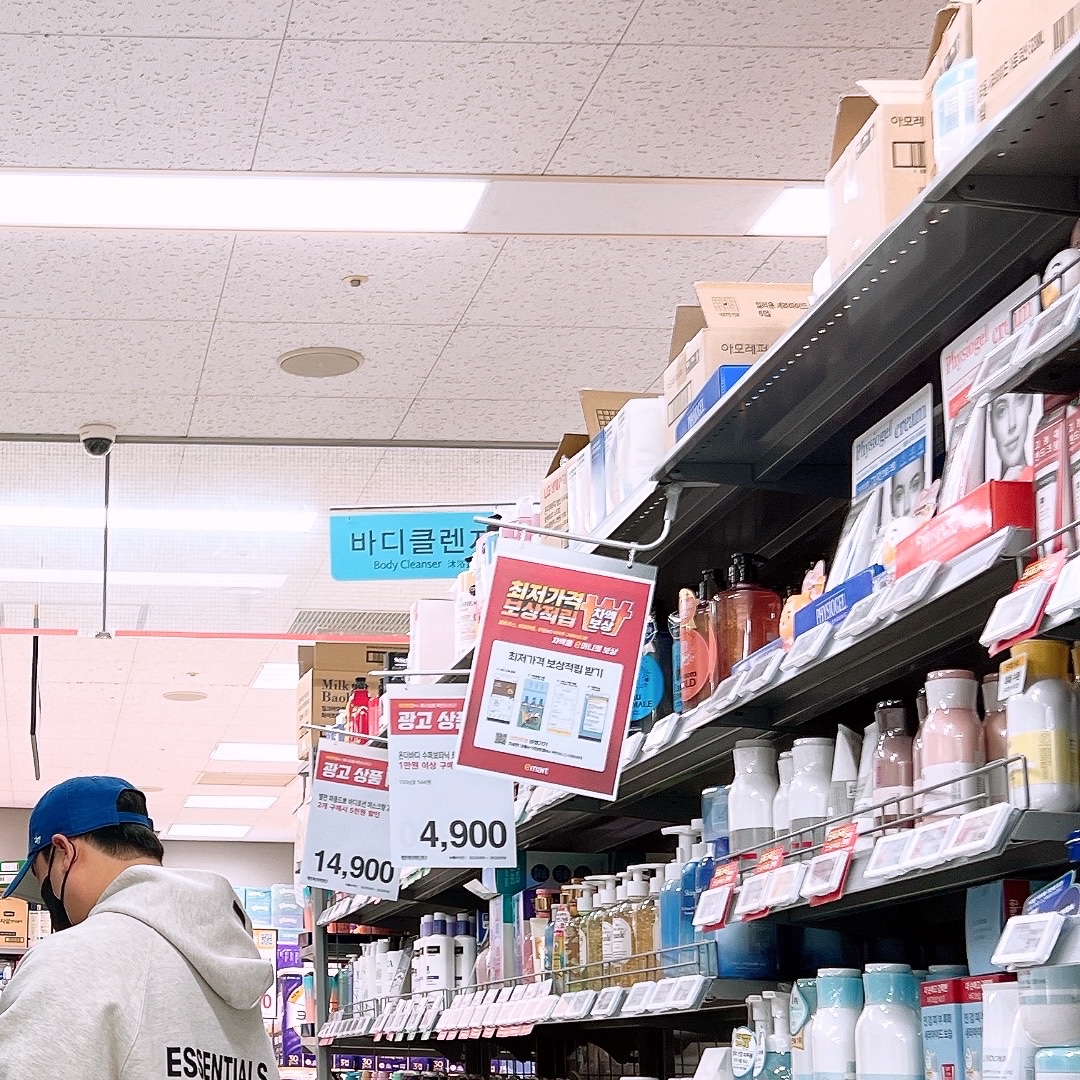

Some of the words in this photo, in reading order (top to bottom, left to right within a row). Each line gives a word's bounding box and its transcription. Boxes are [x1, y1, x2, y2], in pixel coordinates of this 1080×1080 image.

[855, 417, 892, 462] Physiogel
[893, 405, 927, 440] cream
[374, 560, 398, 572] Body
[400, 559, 442, 570] Cleanser
[447, 560, 470, 568] 沐浴
[506, 580, 585, 611] 최저가격
[816, 591, 847, 624] PHYSIOGEL
[501, 598, 579, 628] 보상적립
[588, 618, 616, 632] 보상
[592, 608, 618, 620] 차액
[508, 651, 545, 668] 최저가격
[546, 658, 584, 675] 보상적립
[585, 665, 604, 679] 받기
[322, 679, 349, 690] Milk
[397, 711, 432, 731] 광고
[322, 762, 351, 780] 광고
[354, 767, 384, 786] 상품
[523, 763, 549, 776] emart
[420, 820, 507, 852] 4,900
[314, 849, 395, 884] 14,900
